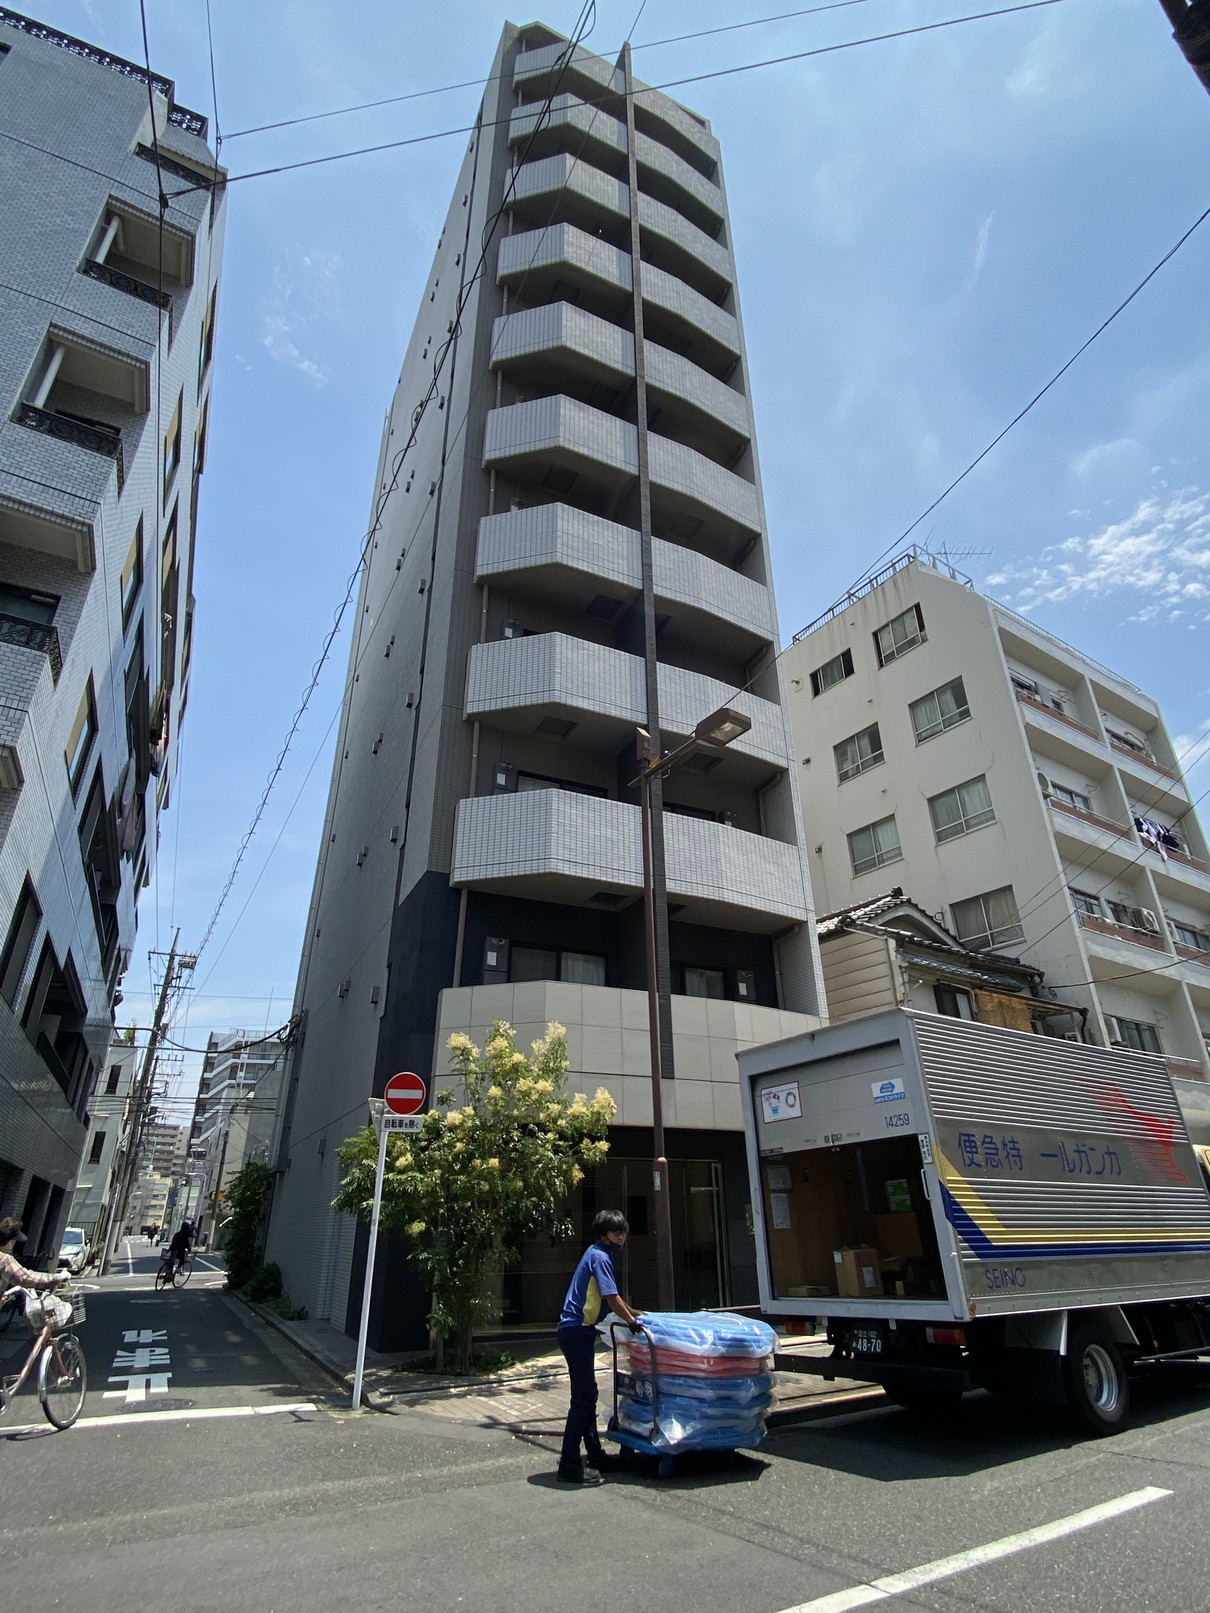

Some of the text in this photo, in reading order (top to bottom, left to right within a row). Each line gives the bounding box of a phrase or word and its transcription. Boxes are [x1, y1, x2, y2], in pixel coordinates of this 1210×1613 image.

[384, 1119, 419, 1129] 自転車を除く
[885, 1113, 910, 1128] 14259
[985, 1266, 1026, 1289] SEINO
[857, 1338, 881, 1352] 48-70
